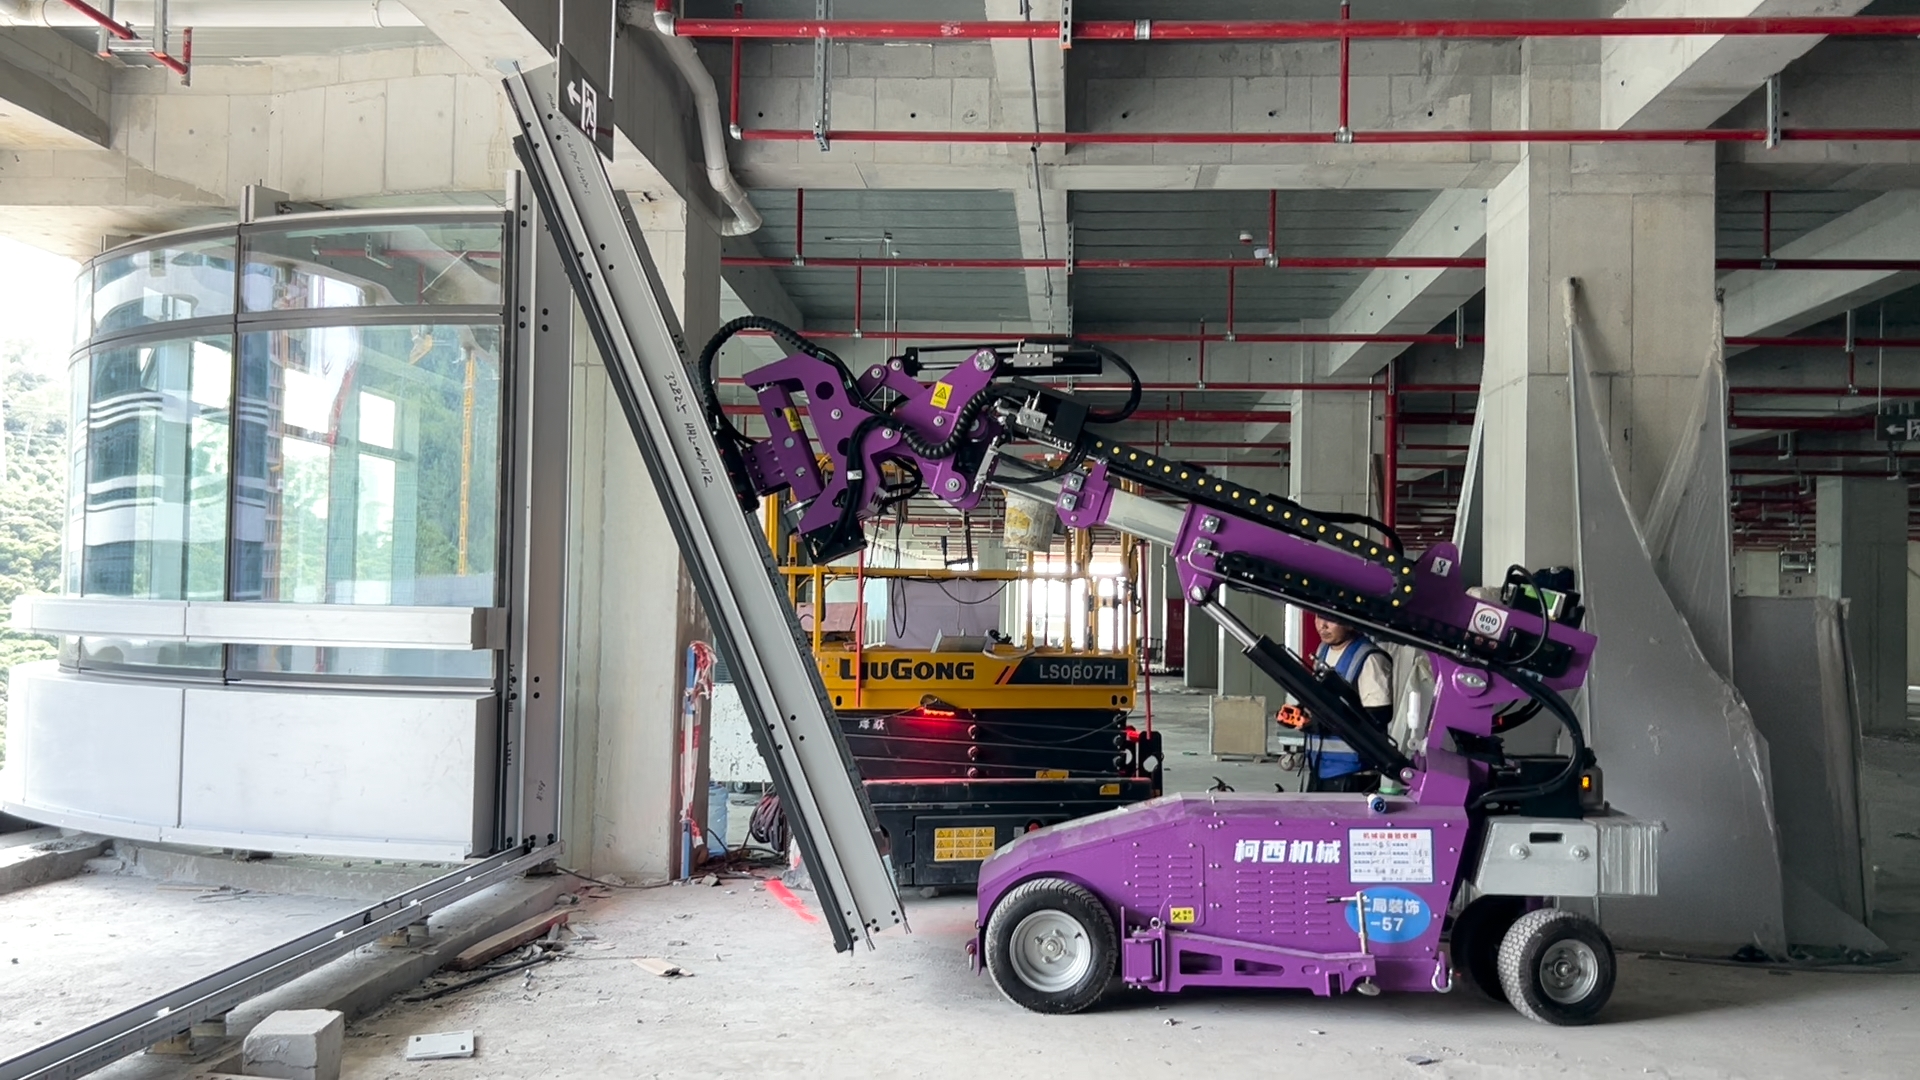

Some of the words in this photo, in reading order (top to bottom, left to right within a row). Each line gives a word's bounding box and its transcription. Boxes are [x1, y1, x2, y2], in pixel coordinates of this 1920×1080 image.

[1479, 613, 1498, 626] 800
[1039, 664, 1116, 680] LS0607H
[1233, 839, 1342, 864] 柯西机械
[1370, 917, 1404, 932] -57
